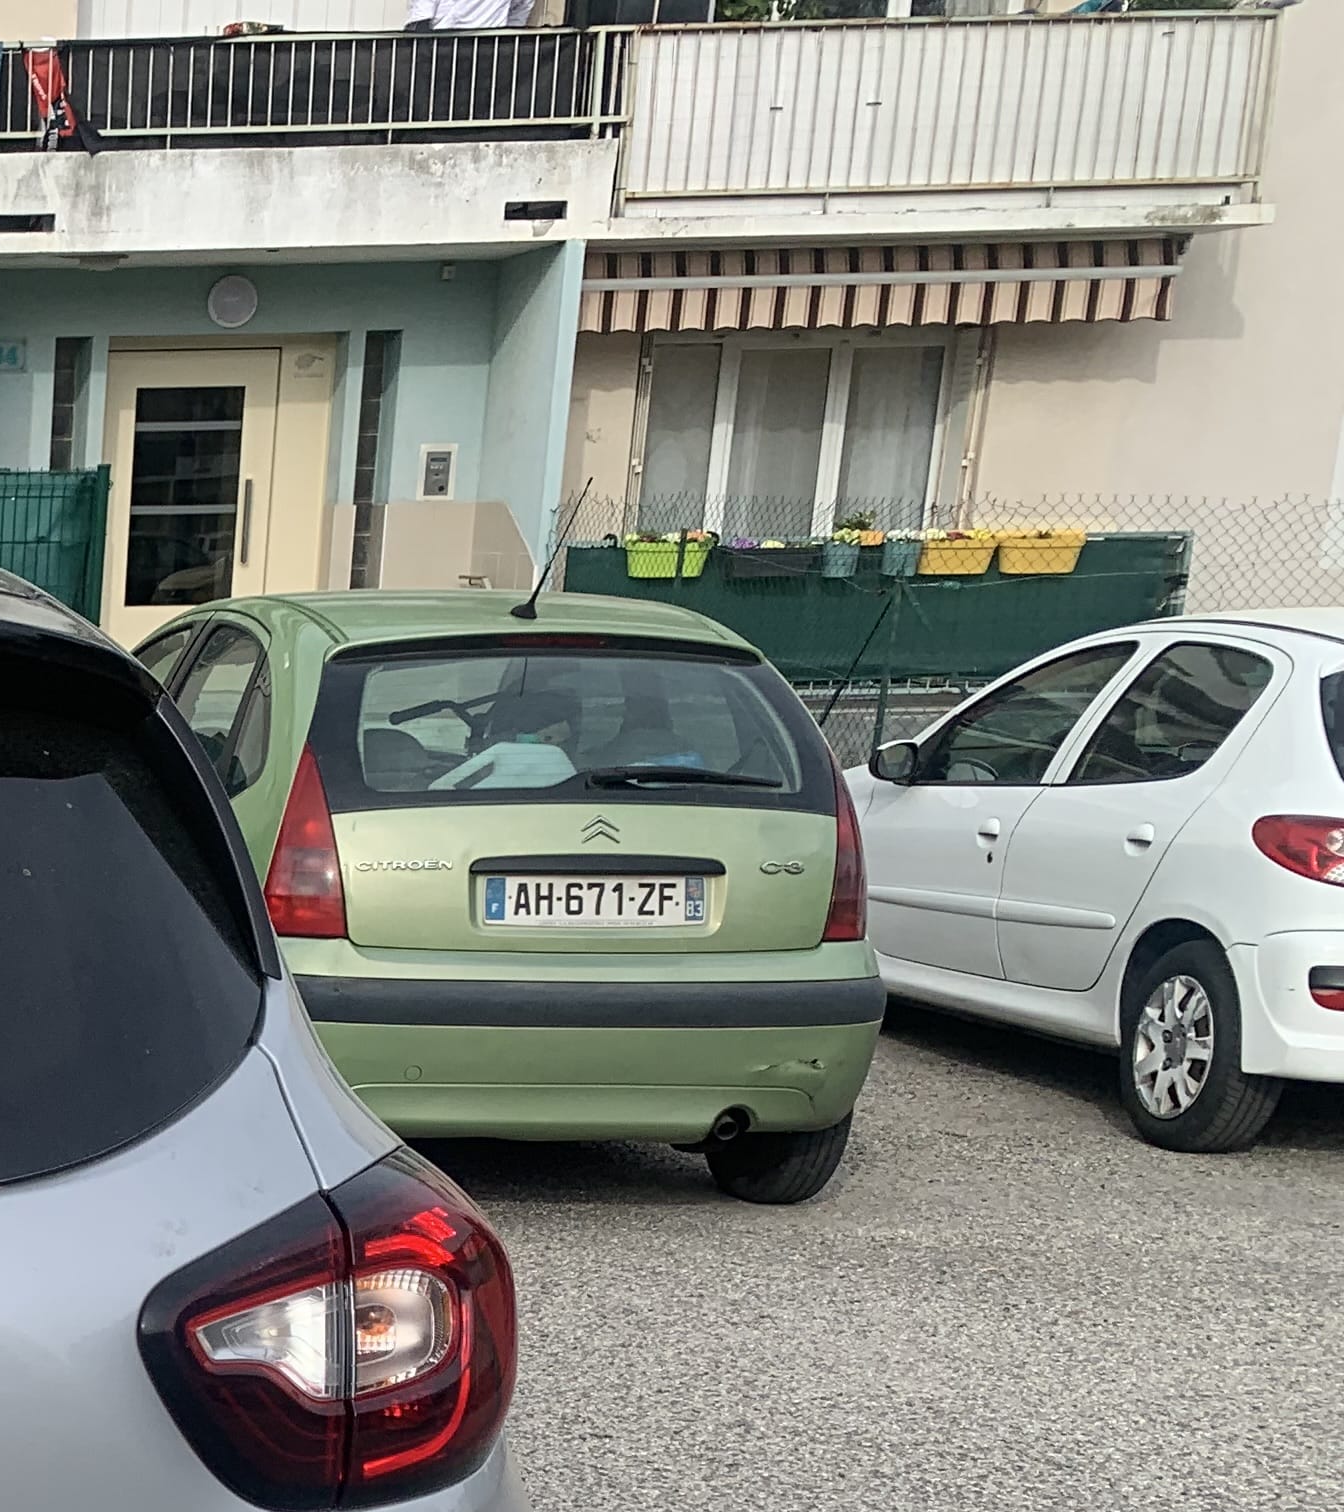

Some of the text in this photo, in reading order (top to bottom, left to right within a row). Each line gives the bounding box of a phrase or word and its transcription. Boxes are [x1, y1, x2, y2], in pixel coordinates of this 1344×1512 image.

[491, 902, 500, 914] F
[513, 882, 677, 917] AH-671-ZF
[685, 900, 704, 917] 83
